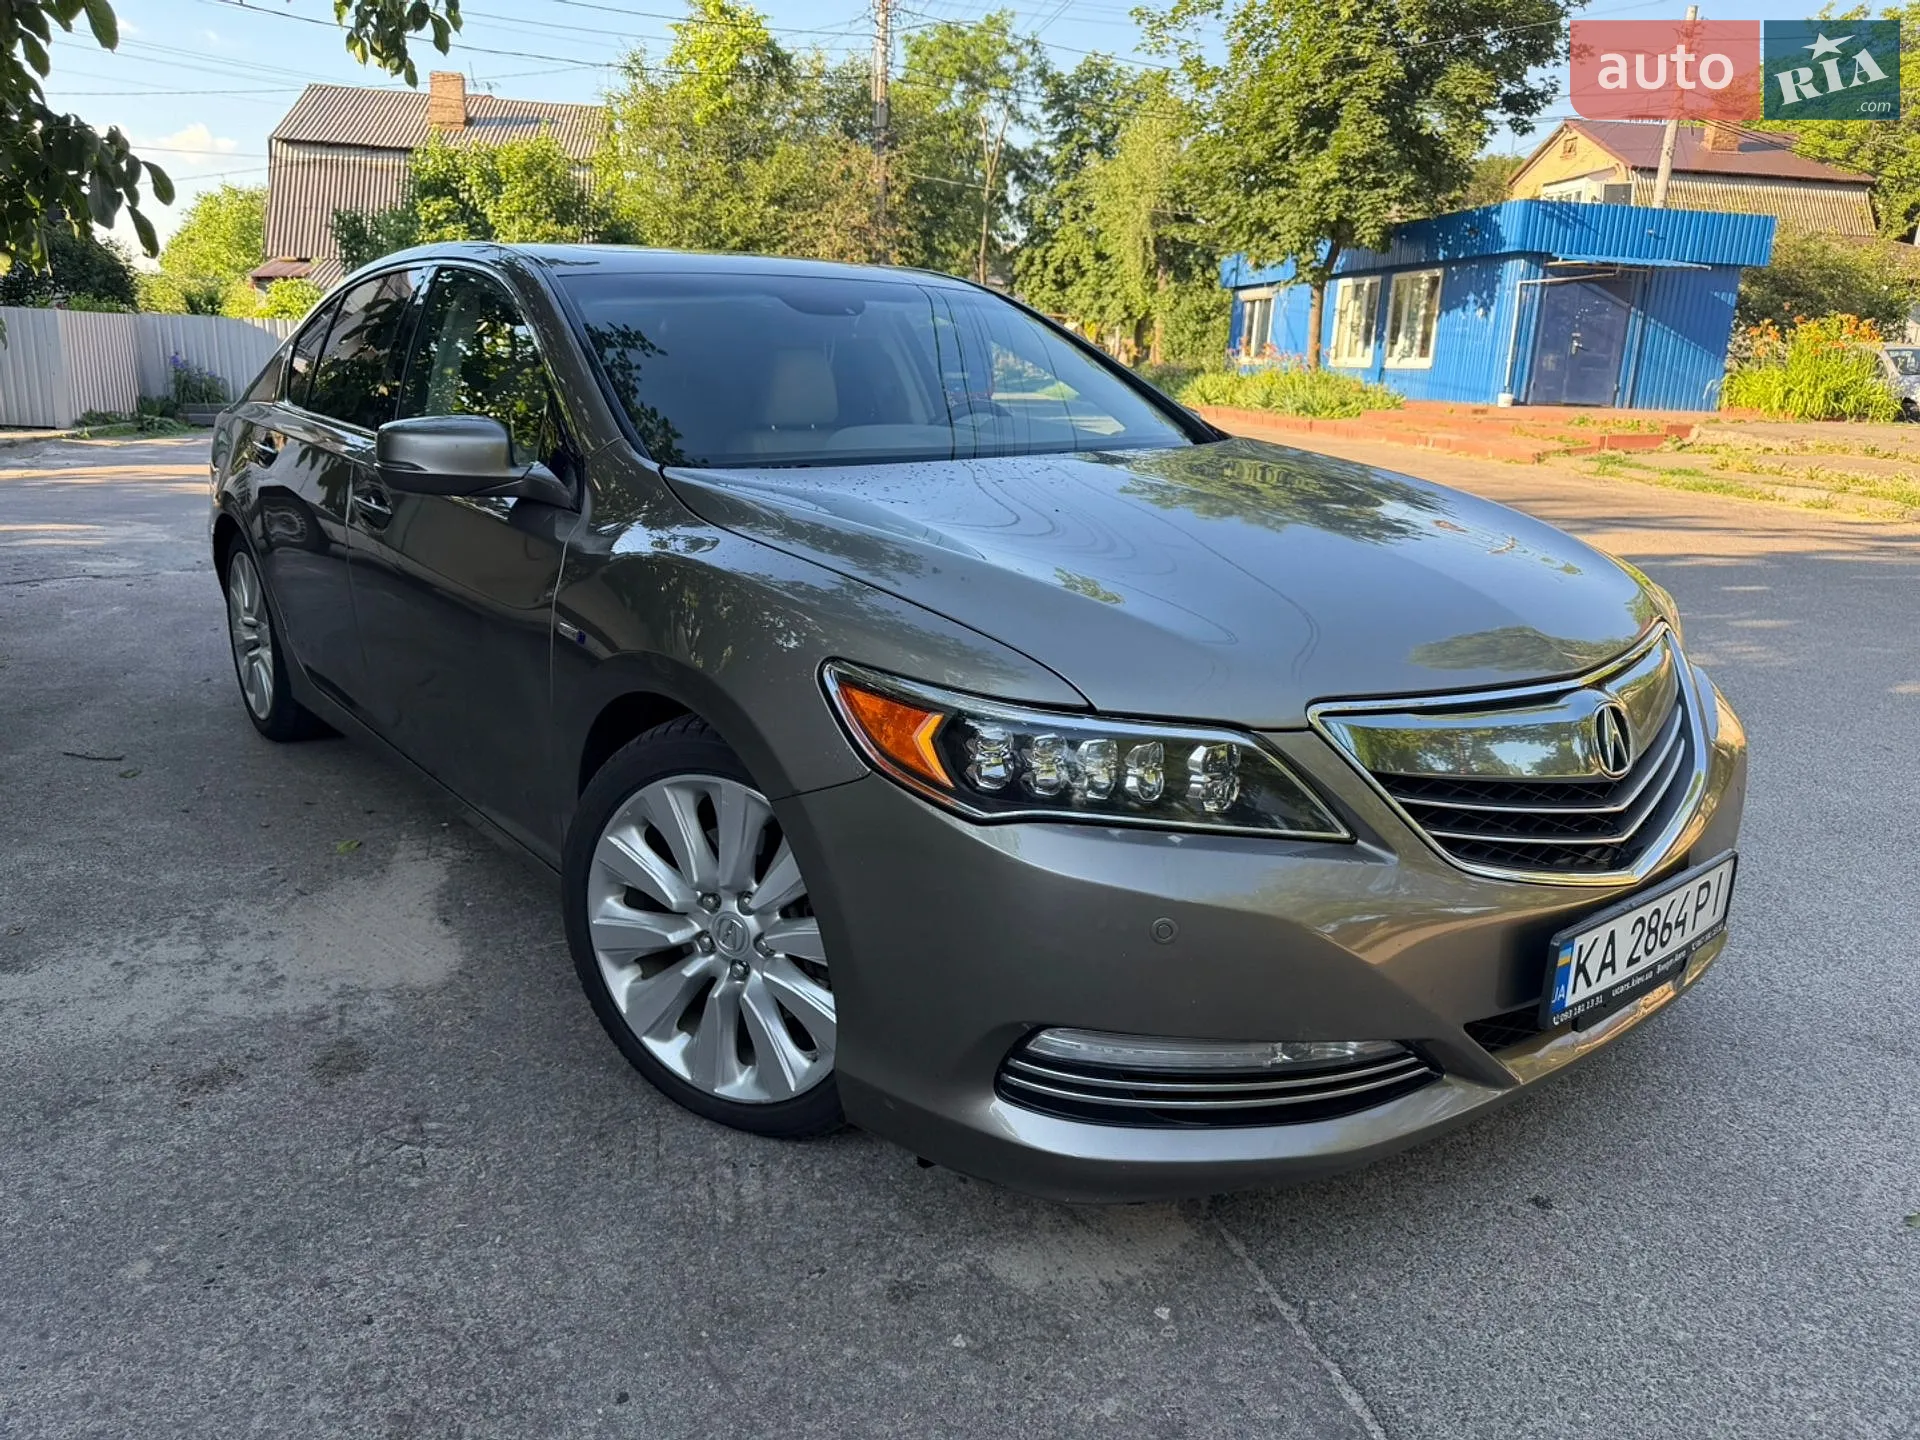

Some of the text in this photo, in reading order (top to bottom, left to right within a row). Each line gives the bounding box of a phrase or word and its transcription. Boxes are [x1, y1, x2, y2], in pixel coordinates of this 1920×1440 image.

[1571, 929, 1616, 994] KA
[1626, 890, 1691, 969] 2864
[1692, 871, 1723, 932] PI
